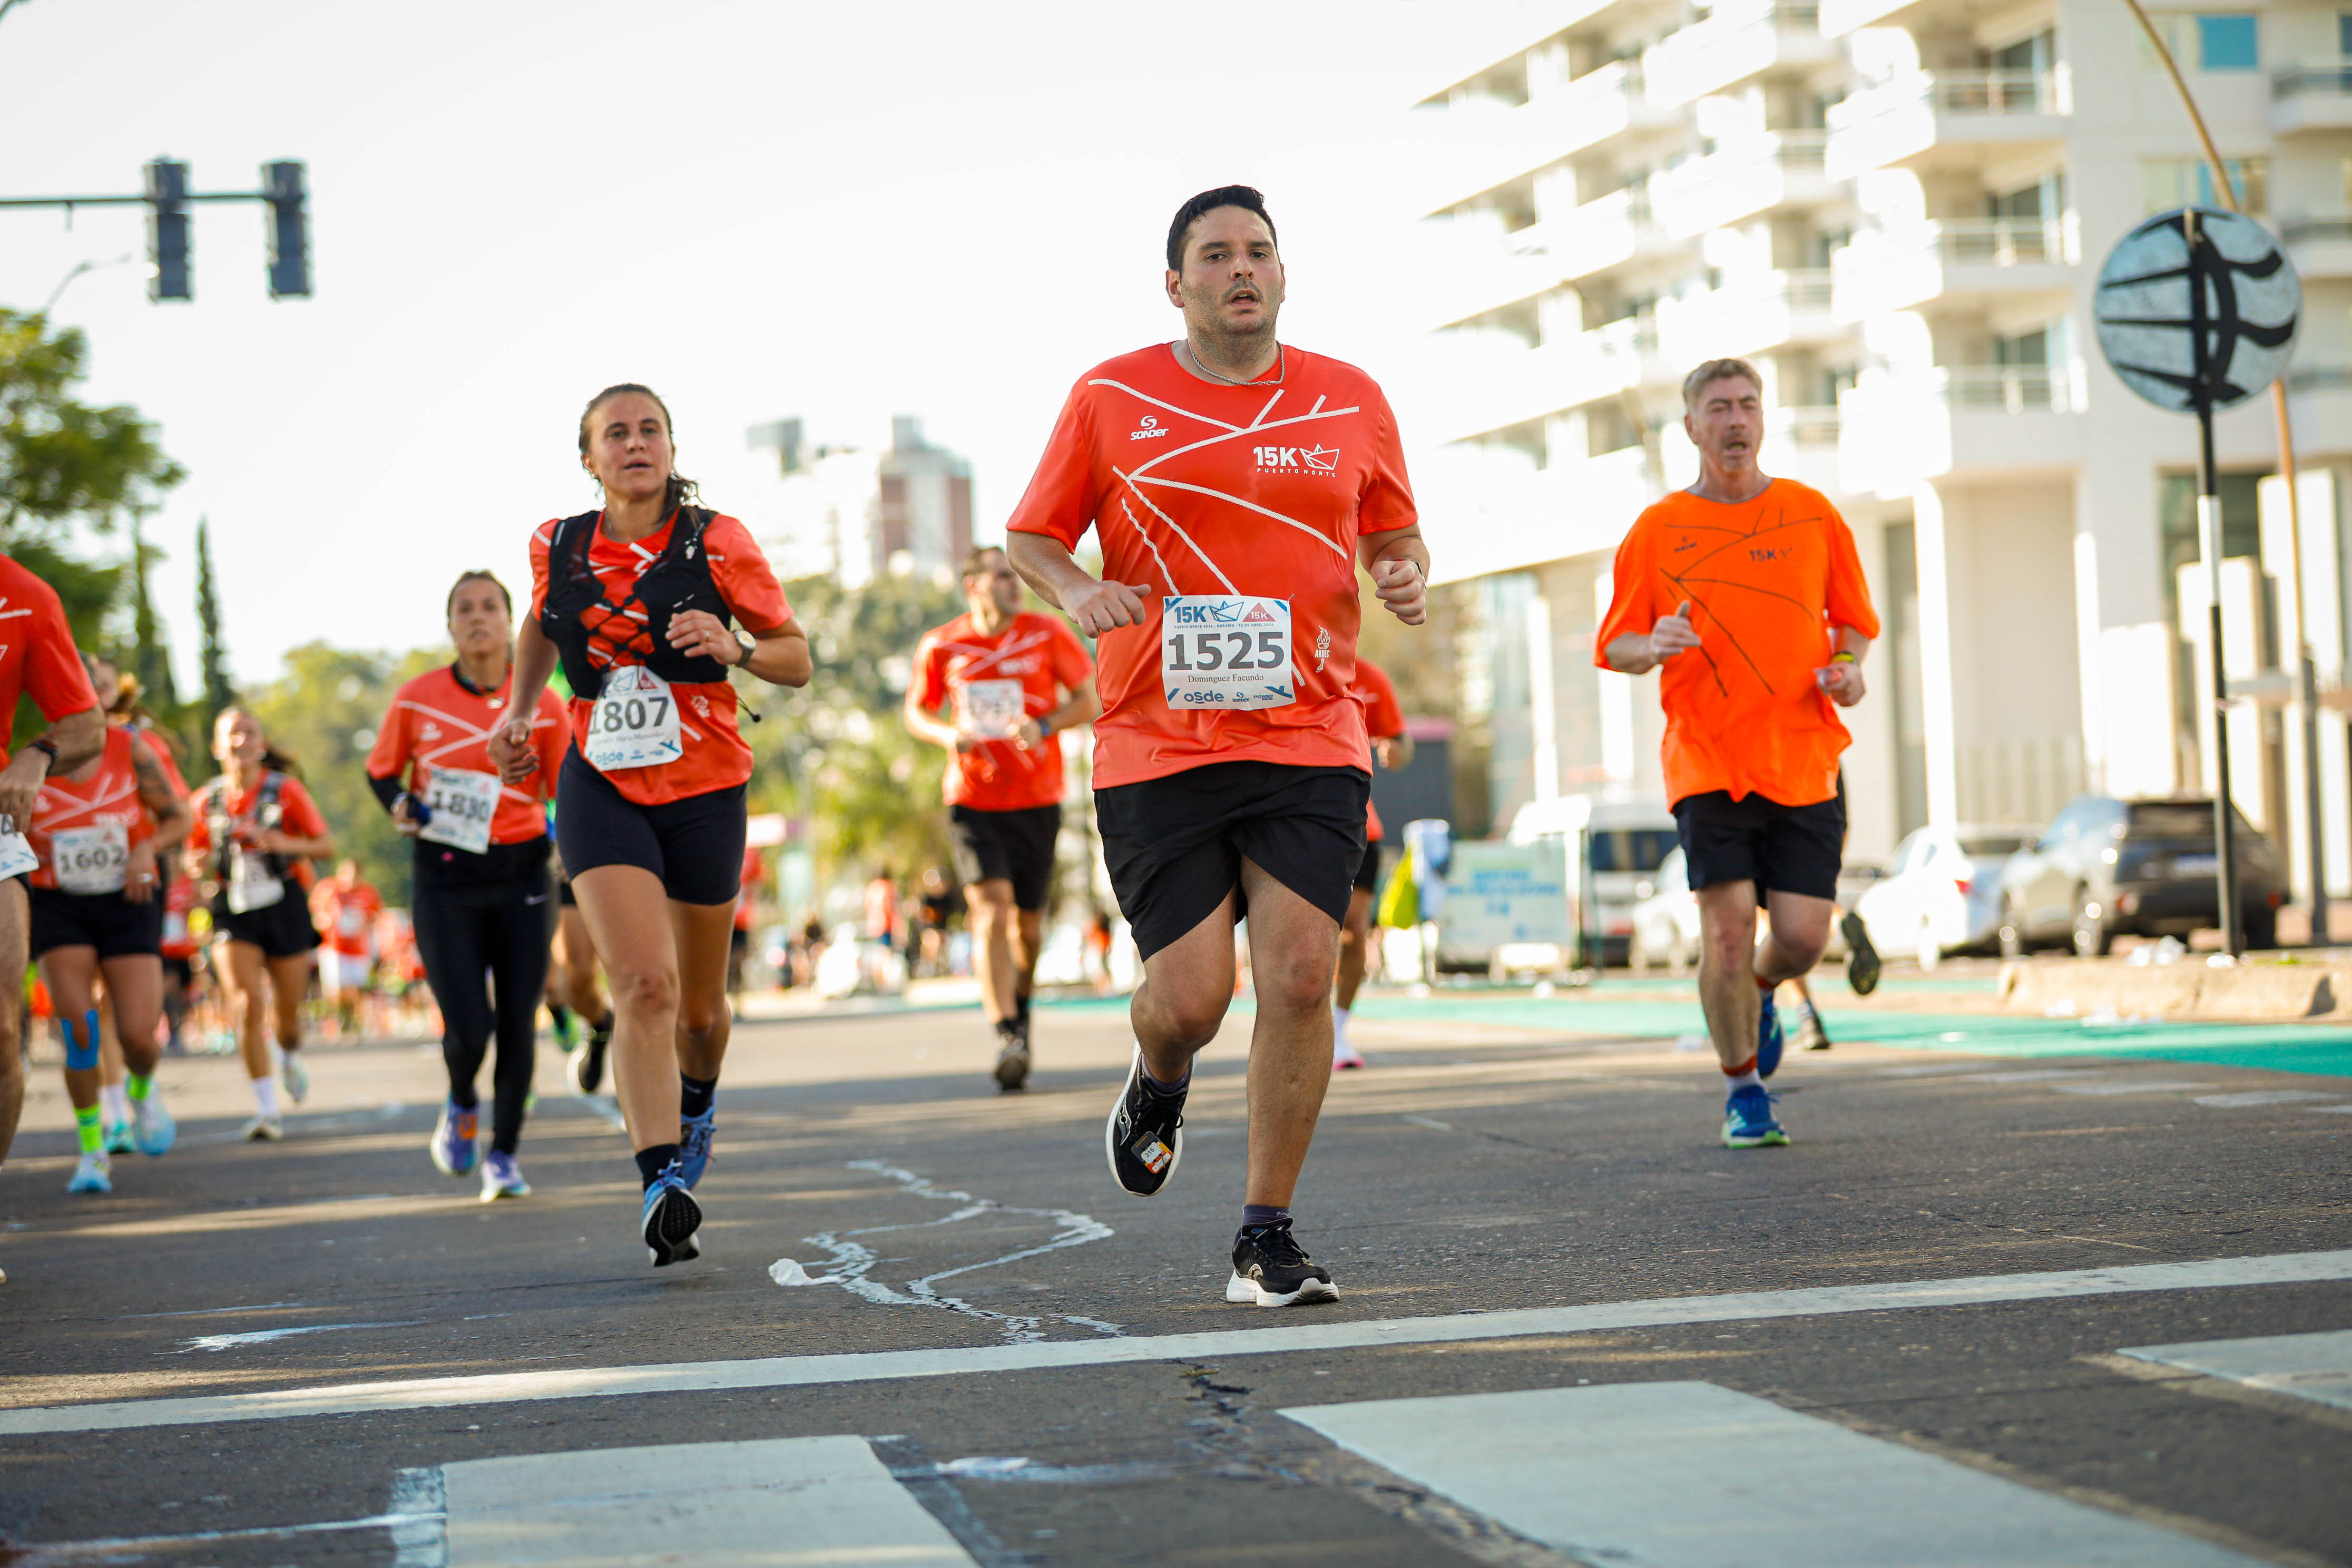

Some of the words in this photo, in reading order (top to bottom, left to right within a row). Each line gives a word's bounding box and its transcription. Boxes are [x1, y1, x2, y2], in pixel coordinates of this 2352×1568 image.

[1253, 446, 1298, 467] 15K
[1304, 469, 1336, 478] NORTE
[1749, 548, 1777, 562] 15K
[1174, 606, 1207, 623] 15K
[1250, 611, 1269, 620] 15K
[1169, 631, 1285, 671] 1525
[1315, 649, 1330, 658] ARDEC
[1188, 675, 1231, 684] Dominguez
[1183, 690, 1224, 703] osde
[589, 697, 669, 735] 1807
